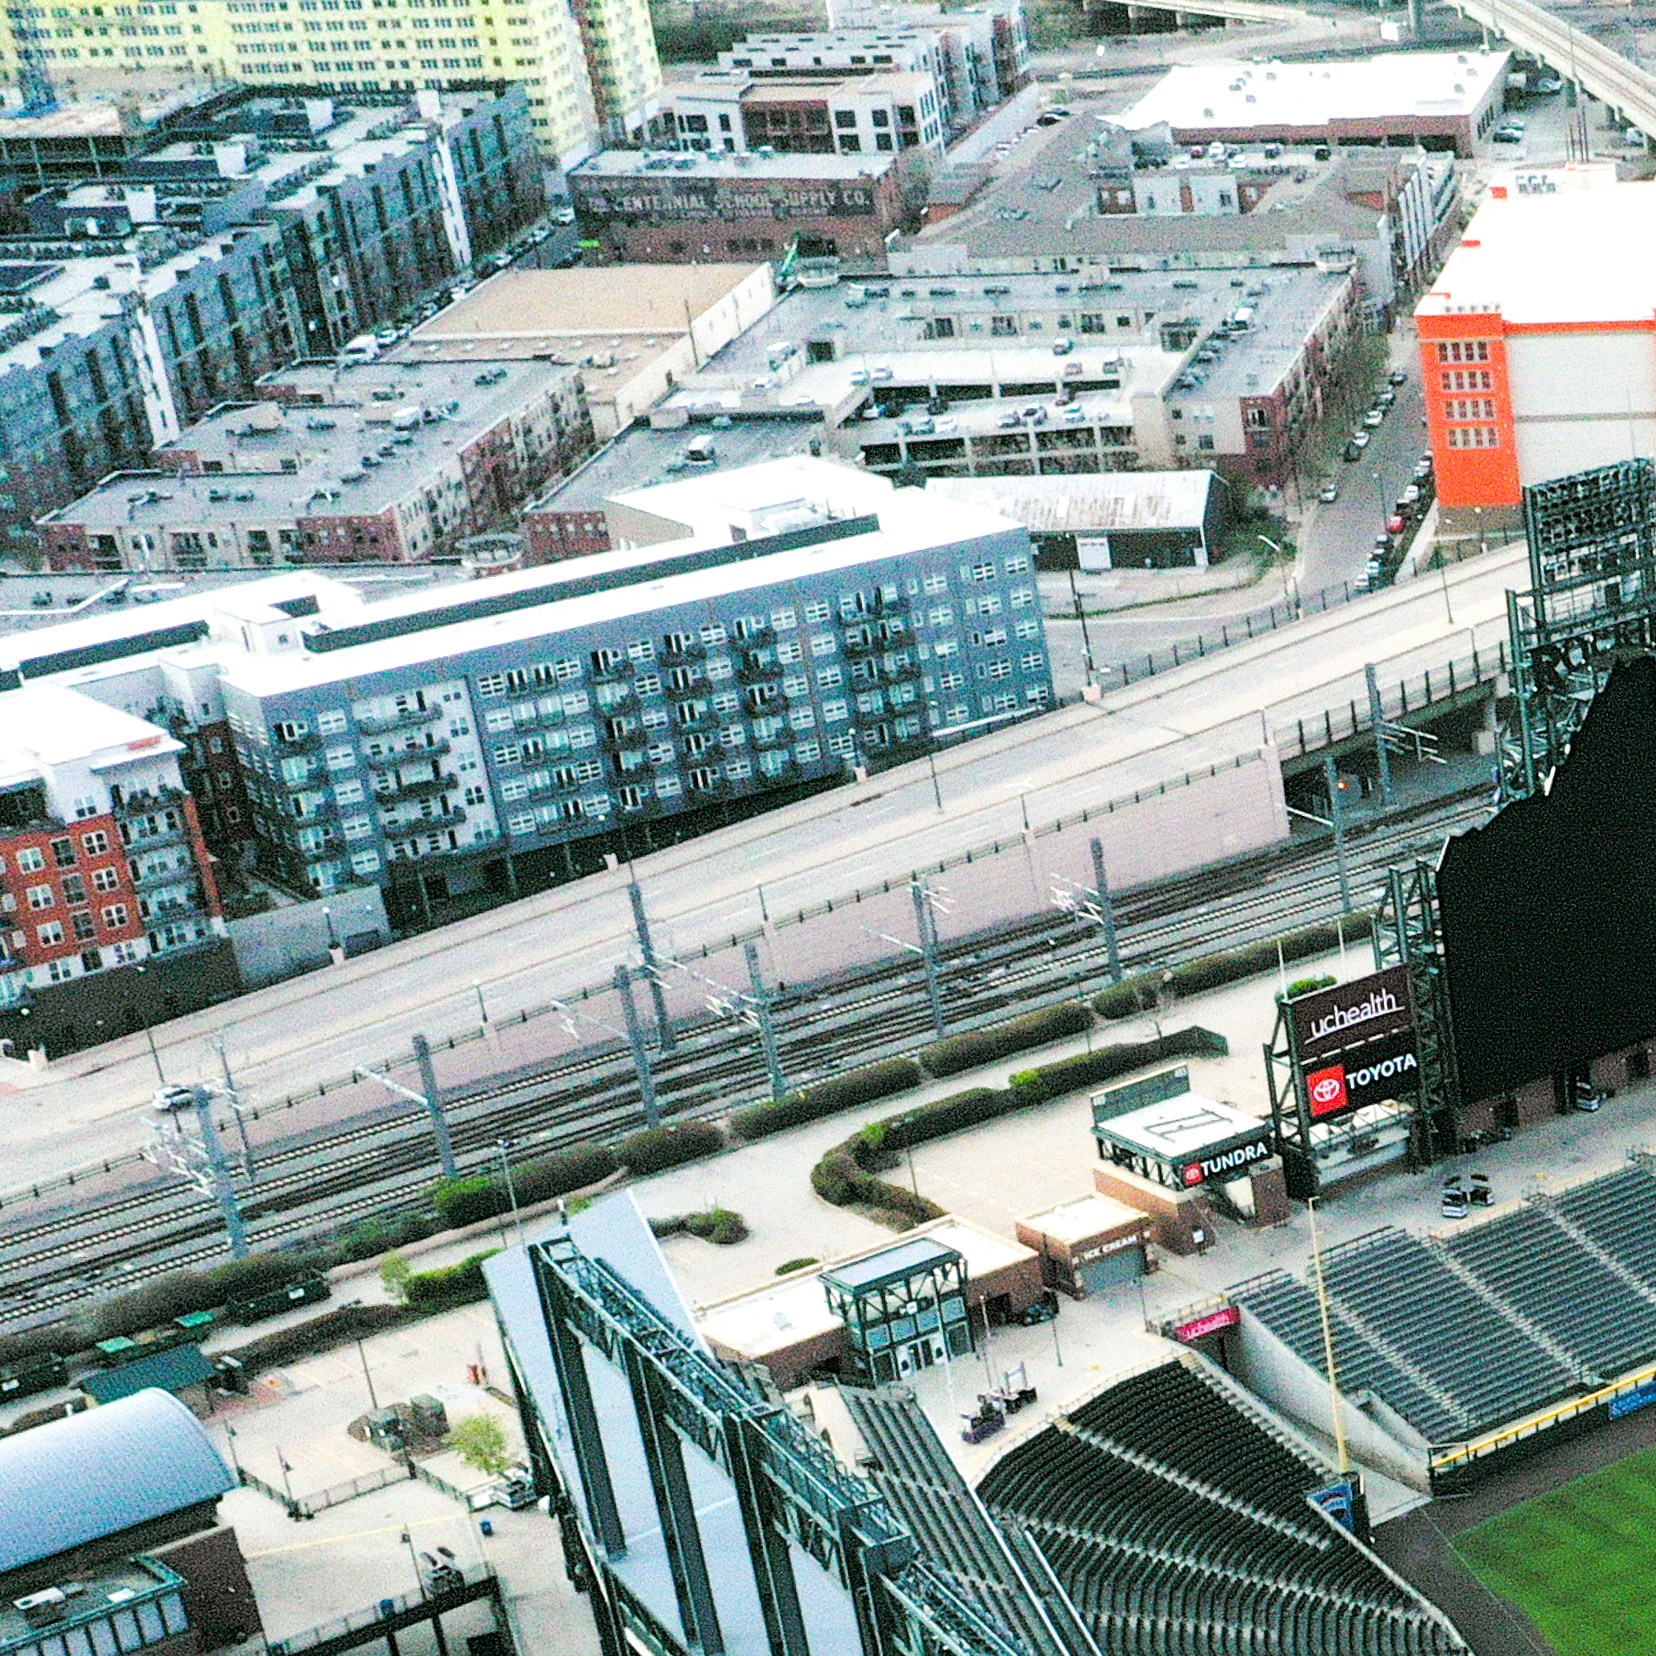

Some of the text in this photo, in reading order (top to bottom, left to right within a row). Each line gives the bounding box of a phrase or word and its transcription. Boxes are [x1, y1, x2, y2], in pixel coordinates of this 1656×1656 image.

[1308, 988, 1400, 1042] uchealth
[1346, 1053, 1417, 1090] TOYOTA
[1200, 1141, 1268, 1177] TUNDRA
